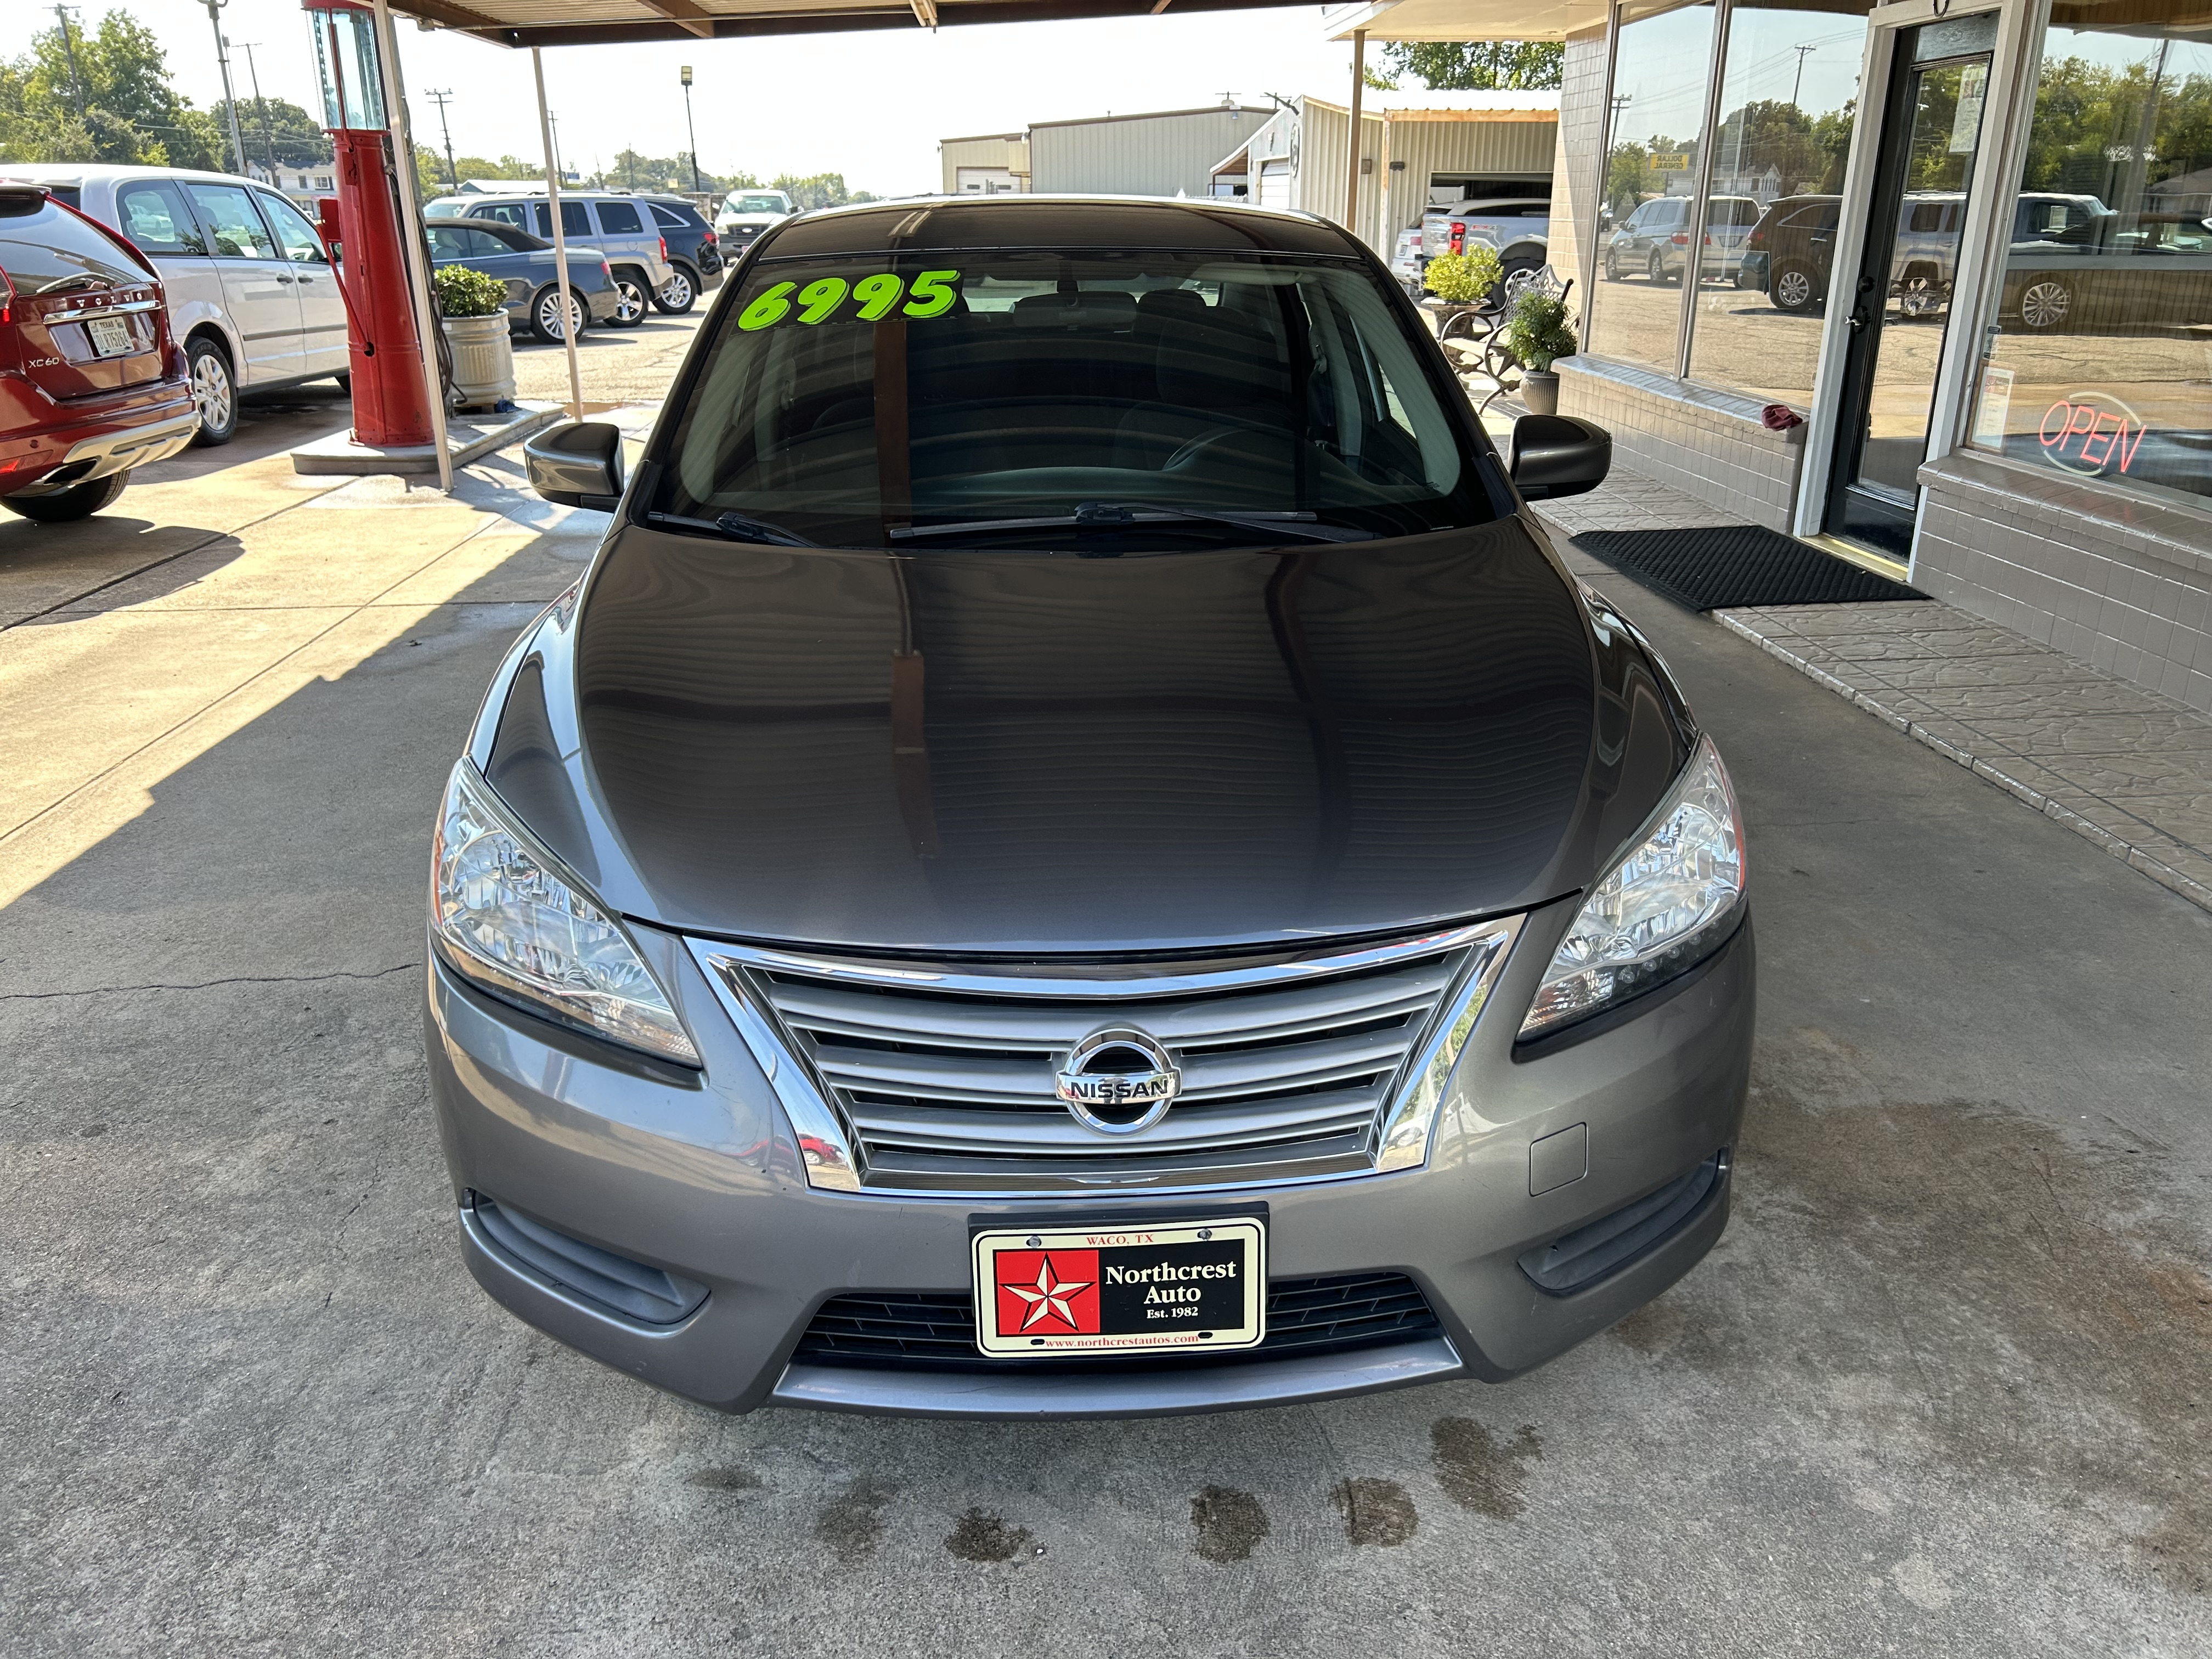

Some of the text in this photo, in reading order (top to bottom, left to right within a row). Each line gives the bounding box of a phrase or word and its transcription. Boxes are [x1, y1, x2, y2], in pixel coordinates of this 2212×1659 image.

[76, 292, 142, 307] VOLVO
[738, 270, 961, 331] 6995
[99, 320, 114, 329] TEXAS
[2039, 400, 2148, 473] OPEN
[1071, 1079, 1168, 1098] NISSAN
[1086, 1234, 1154, 1246] WACO, TX
[1105, 1261, 1237, 1284] Northcrest
[1143, 1285, 1201, 1304] Auto
[1147, 1306, 1199, 1319] Est. 1982
[1046, 1335, 1199, 1347] www.northcrestautos.com
